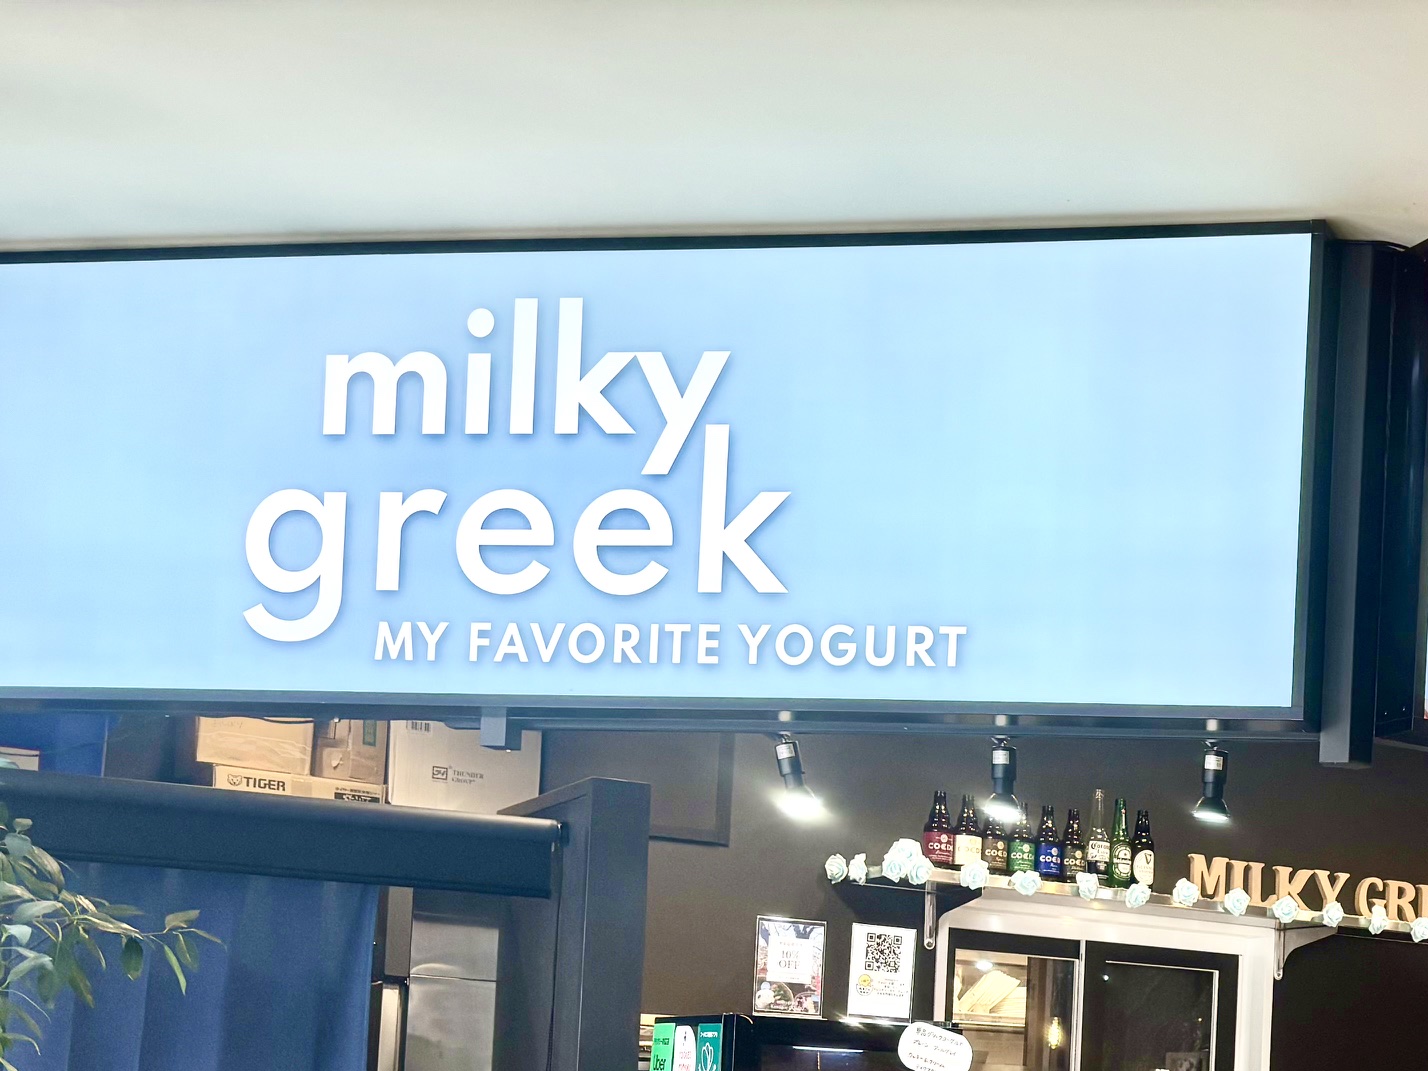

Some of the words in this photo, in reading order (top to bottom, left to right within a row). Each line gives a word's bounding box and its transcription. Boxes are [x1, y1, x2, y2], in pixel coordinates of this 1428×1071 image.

[322, 297, 731, 475] milky
[242, 424, 792, 642] greek
[373, 621, 450, 662] MY
[469, 622, 721, 665] FAVORITE
[737, 624, 968, 668] YOGURT
[243, 776, 286, 792] TIGER
[985, 849, 1007, 857] COED
[1011, 852, 1034, 860] COED
[1064, 858, 1085, 866] COED
[1187, 853, 1350, 912] MILKY
[652, 1054, 667, 1071] Uber
